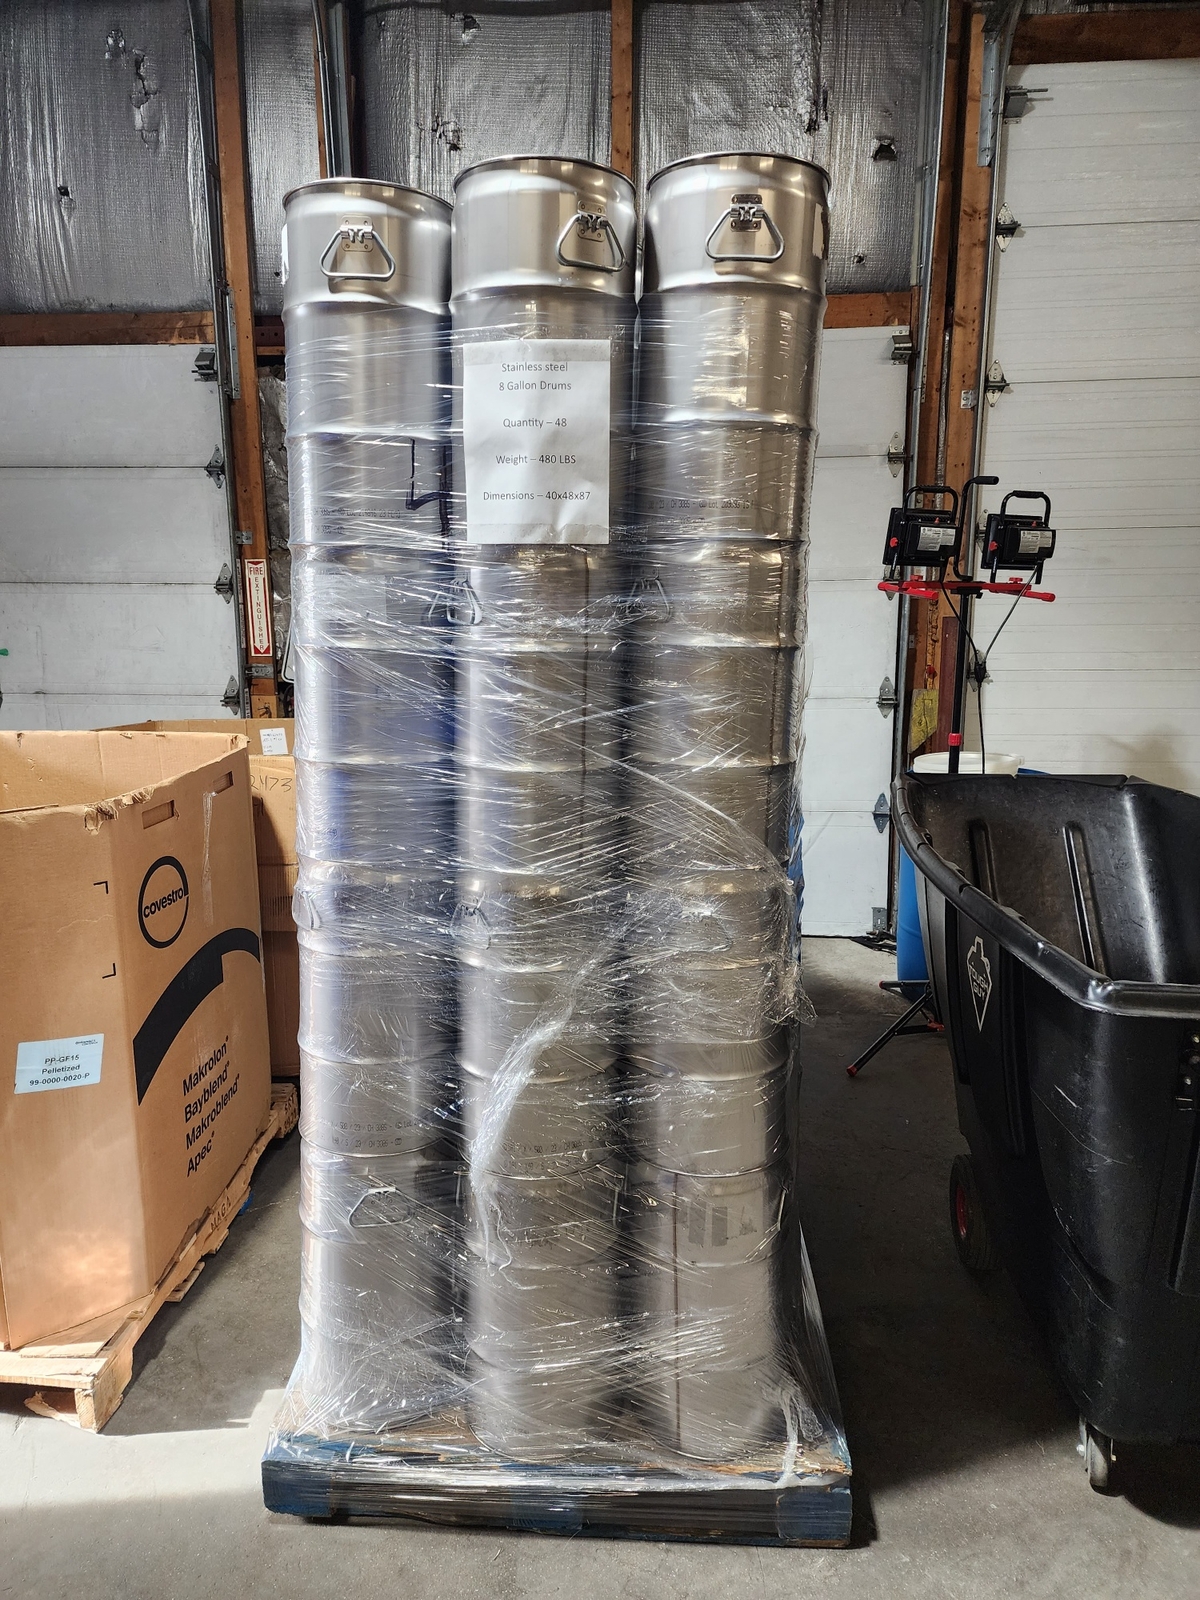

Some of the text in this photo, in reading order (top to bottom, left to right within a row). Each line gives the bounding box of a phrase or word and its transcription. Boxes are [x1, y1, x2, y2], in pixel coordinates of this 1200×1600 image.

[501, 362, 568, 372] Stainless steel
[498, 381, 572, 391] 8 Gallon Drums
[503, 418, 544, 428] Quantity
[554, 418, 567, 428] 48
[496, 455, 528, 465] Weight
[538, 455, 557, 464] 480
[559, 455, 576, 464] LBS
[483, 491, 535, 500] Dimensions
[545, 491, 591, 500] 40x48x87
[249, 566, 264, 576] FIRE
[254, 577, 264, 651] EXTINGUISHER
[143, 887, 184, 919] covestro
[44, 1054, 80, 1064] PP-GF15
[41, 1064, 81, 1075] Pelletized
[29, 1072, 90, 1086] 99-0000-0020-P
[186, 1138, 212, 1178] Apec
